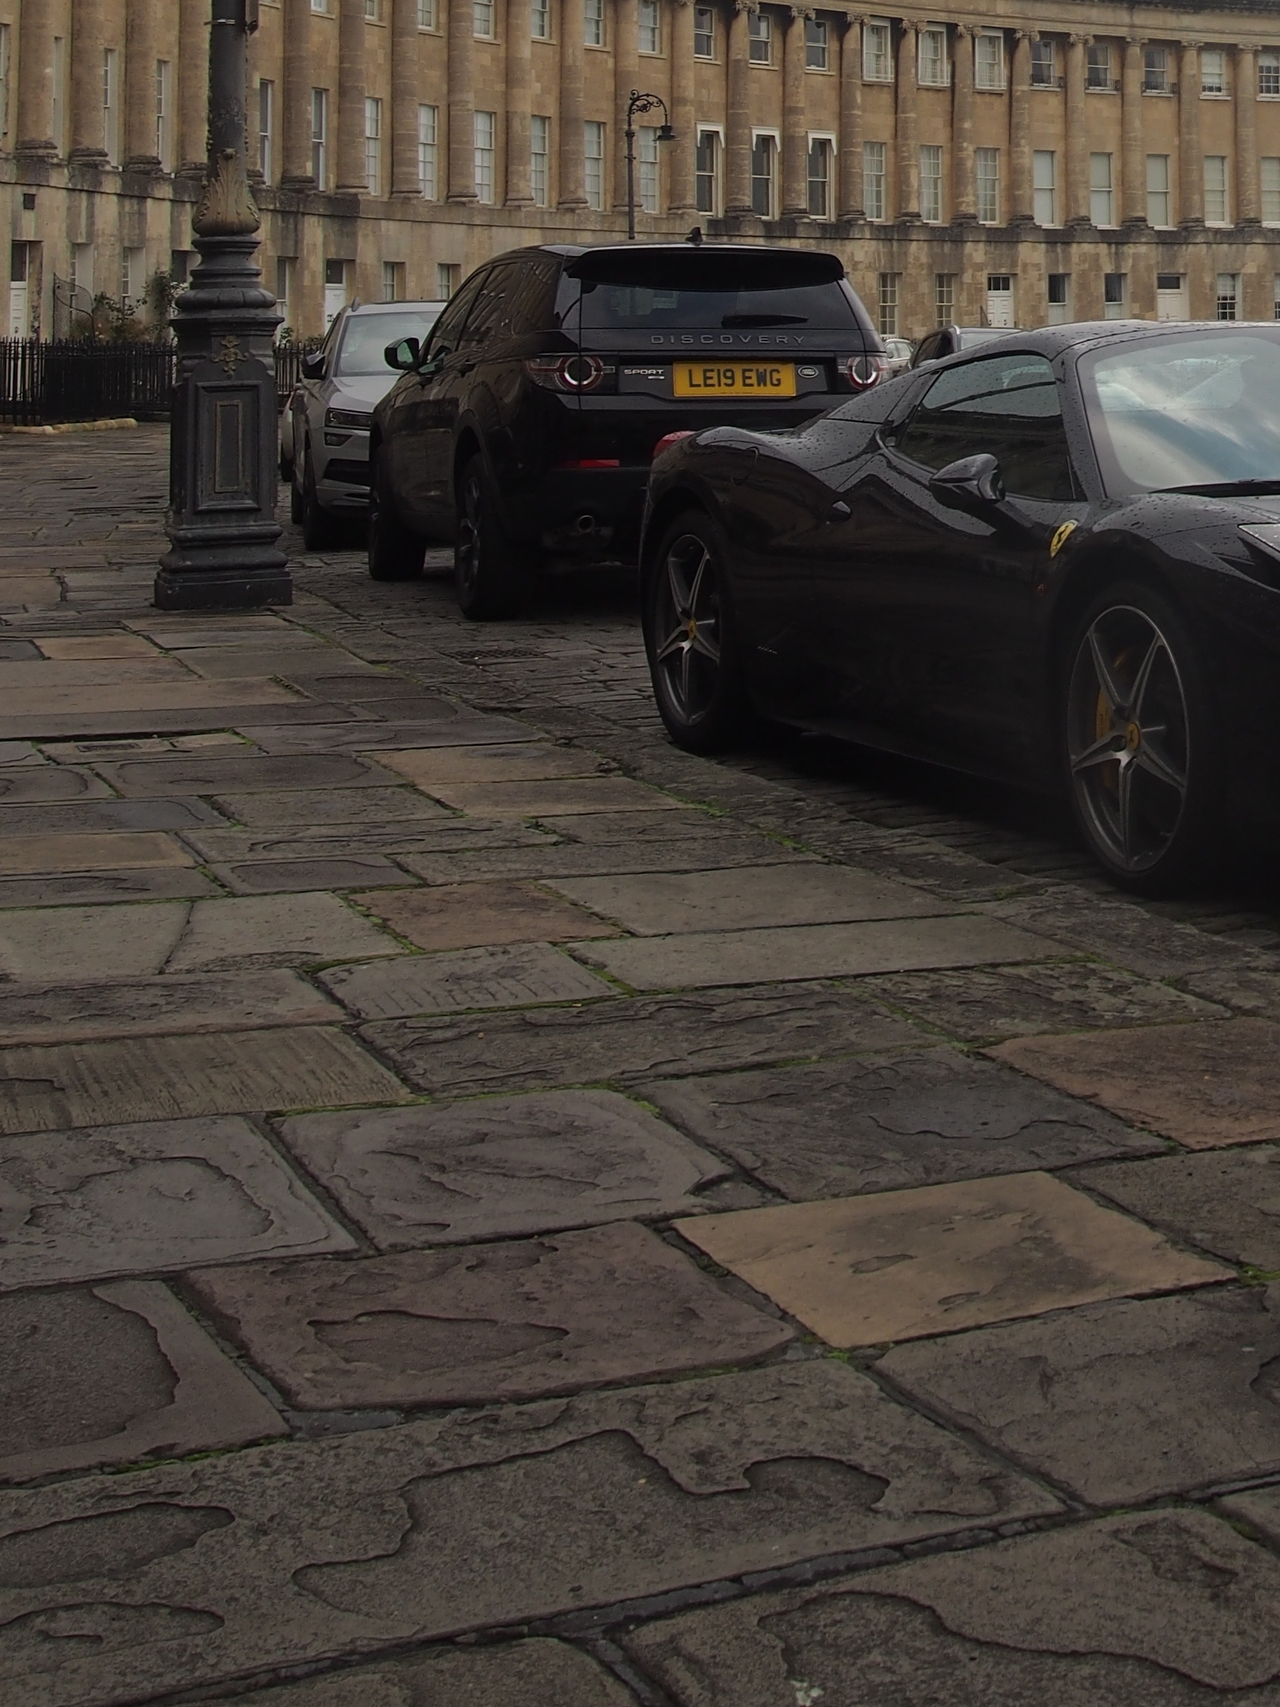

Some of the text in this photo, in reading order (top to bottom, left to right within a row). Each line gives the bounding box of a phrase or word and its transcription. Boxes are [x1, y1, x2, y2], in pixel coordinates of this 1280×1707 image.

[651, 335, 807, 344] DISCOVERY
[688, 368, 781, 388] LE19 EWG
